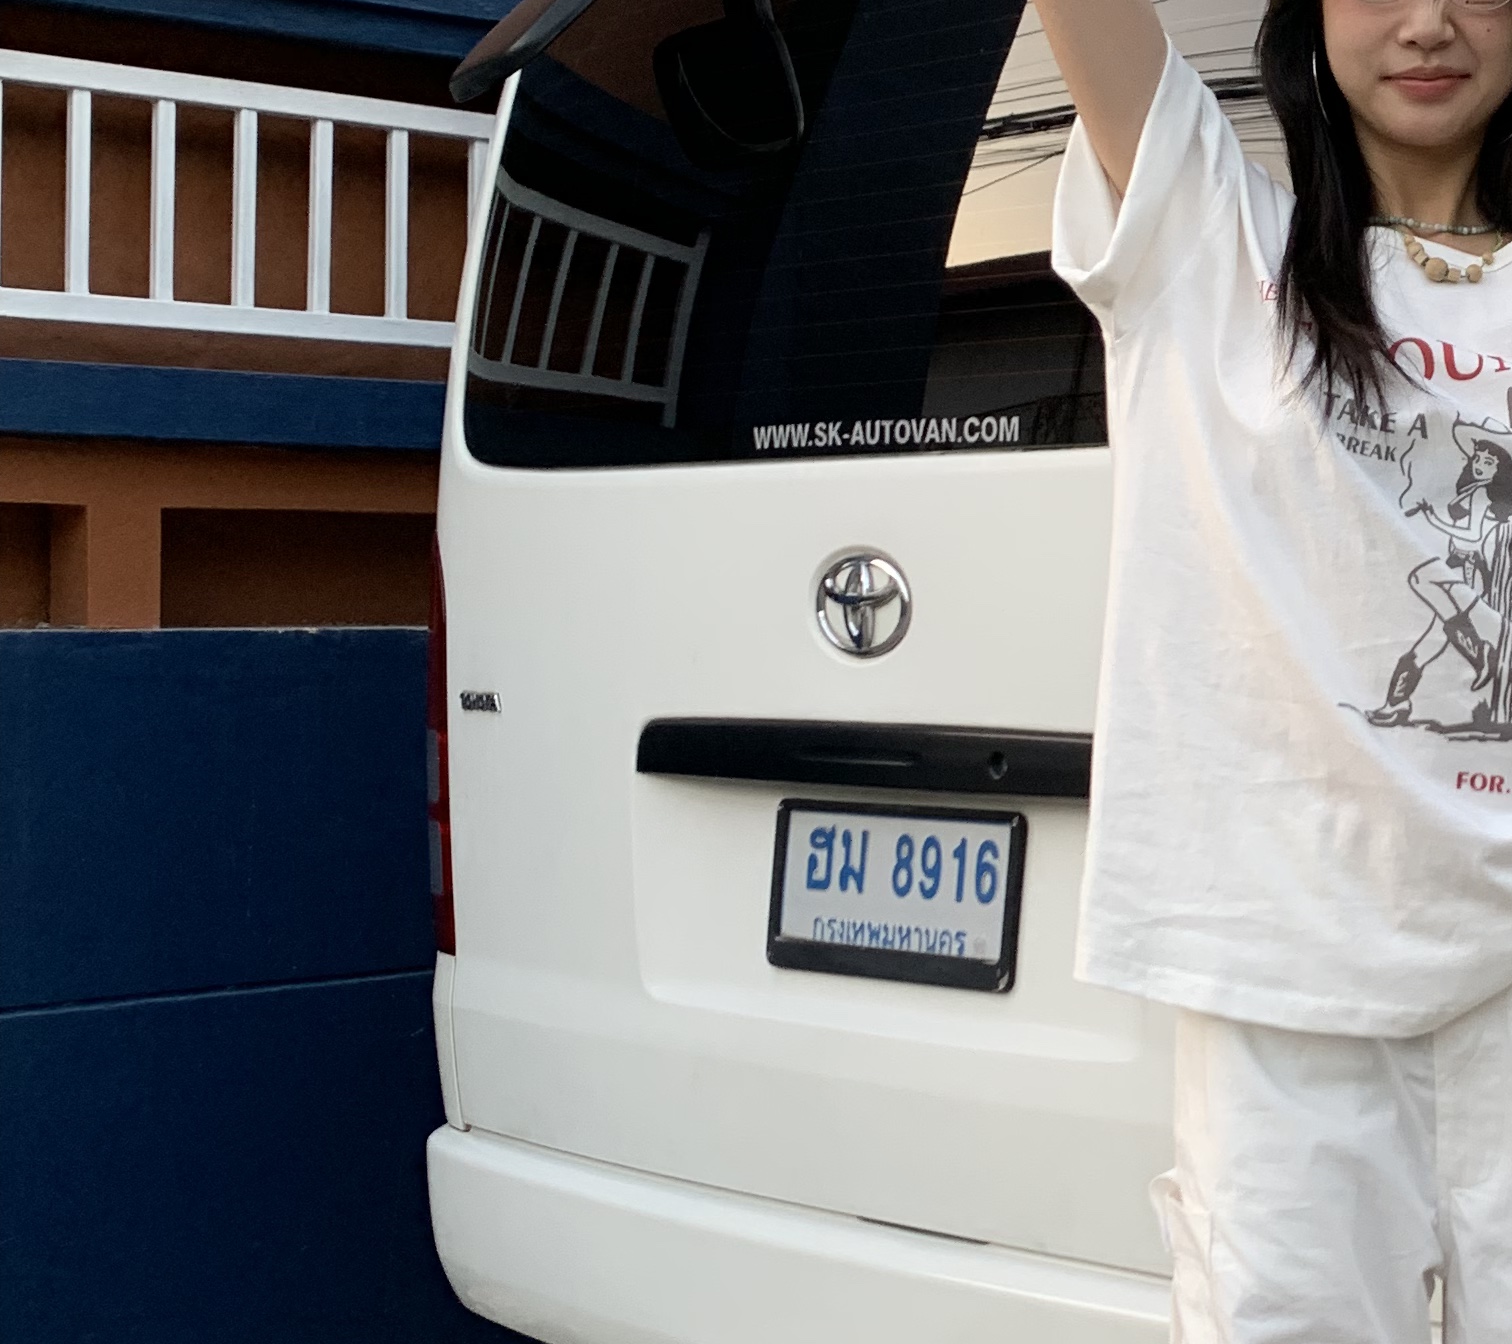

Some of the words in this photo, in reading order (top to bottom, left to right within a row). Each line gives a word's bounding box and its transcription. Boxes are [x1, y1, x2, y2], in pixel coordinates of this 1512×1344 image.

[753, 416, 1020, 450] WWW.SK-AUTOVAN.COM
[1323, 391, 1397, 434] TAKE
[1407, 413, 1428, 439] A
[892, 832, 1000, 905] 8916
